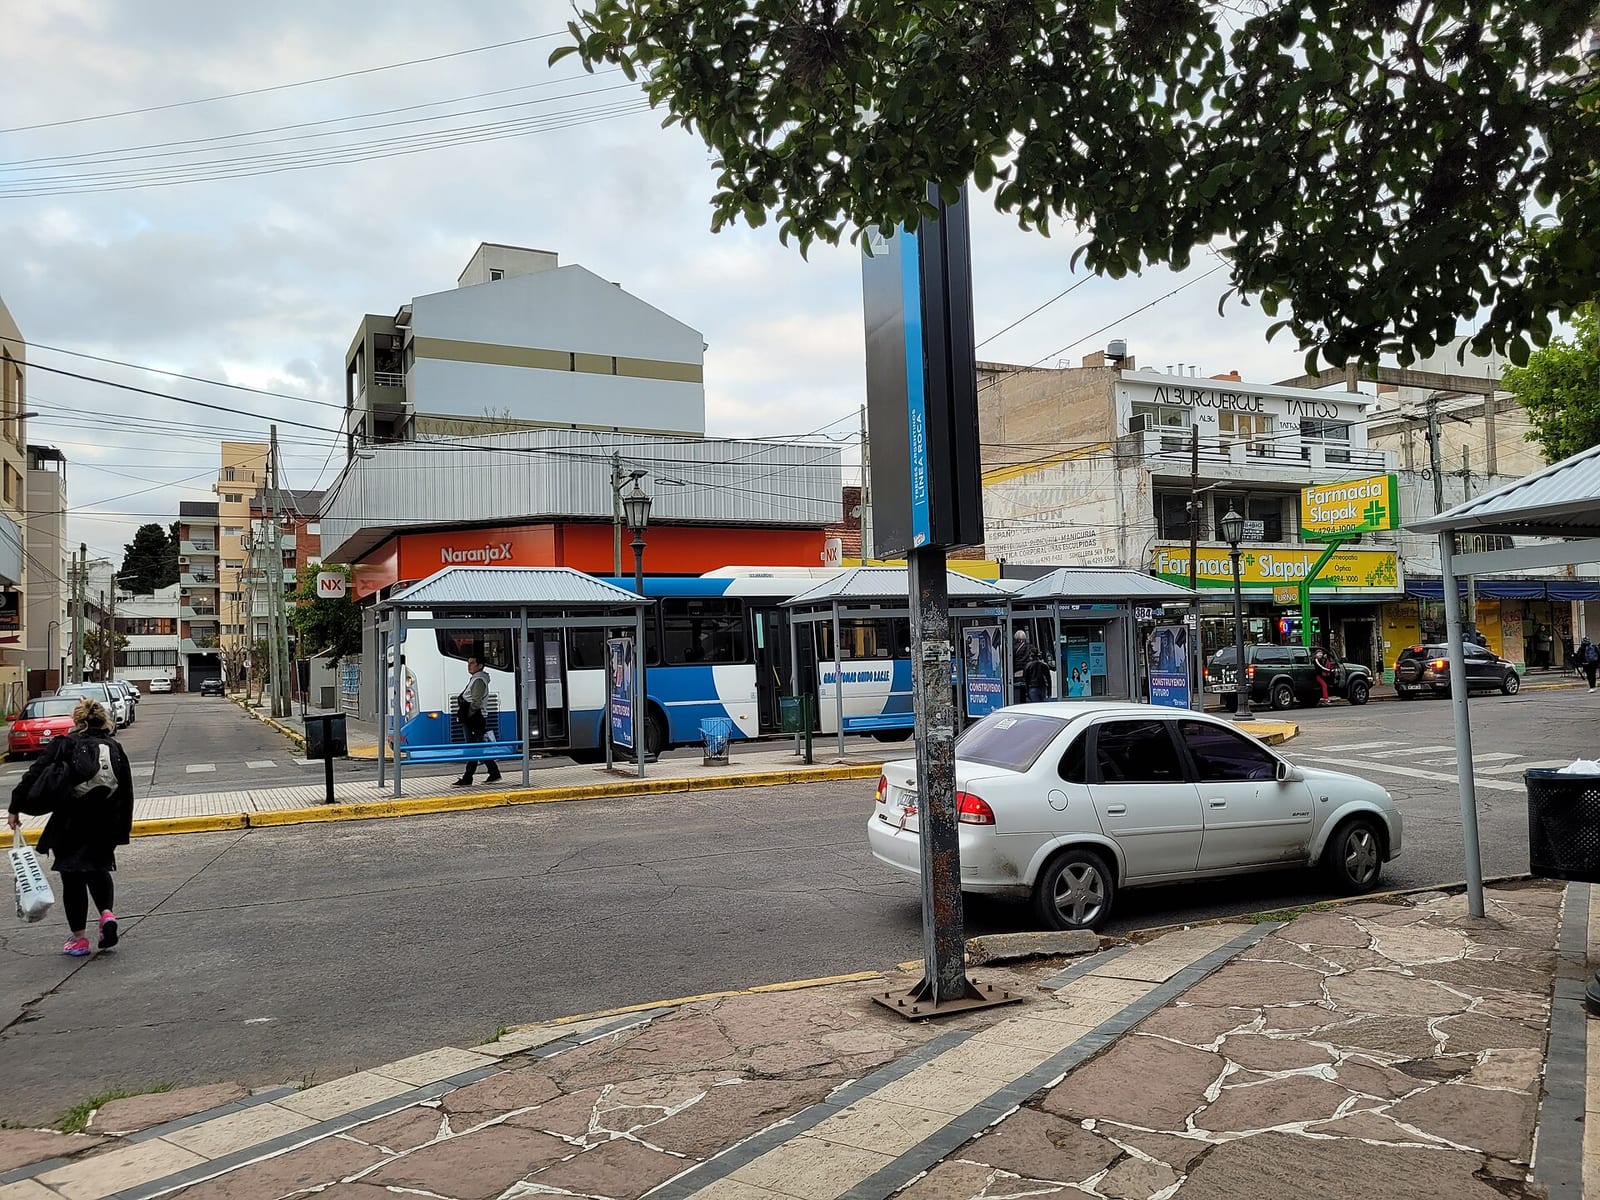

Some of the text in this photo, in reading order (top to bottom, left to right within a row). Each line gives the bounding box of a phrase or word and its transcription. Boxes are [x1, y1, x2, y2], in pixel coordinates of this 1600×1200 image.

[1285, 399, 1338, 419] TATTOO
[916, 412, 924, 453] ROCA
[1306, 480, 1382, 506] Farmacia
[1310, 502, 1358, 524] Slapak
[826, 547, 837, 561] NX
[1258, 555, 1315, 582] Slapak
[1331, 575, 1359, 583] 4294-1000
[321, 579, 341, 591] NX
[1275, 593, 1298, 602] TURNO
[1136, 608, 1151, 618] 384
[969, 682, 1002, 693] CONSTRUYENDO
[1152, 678, 1186, 688] CONSTRUYENDO
[1152, 688, 1170, 697] FUTURO
[969, 694, 988, 704] FUTURO
